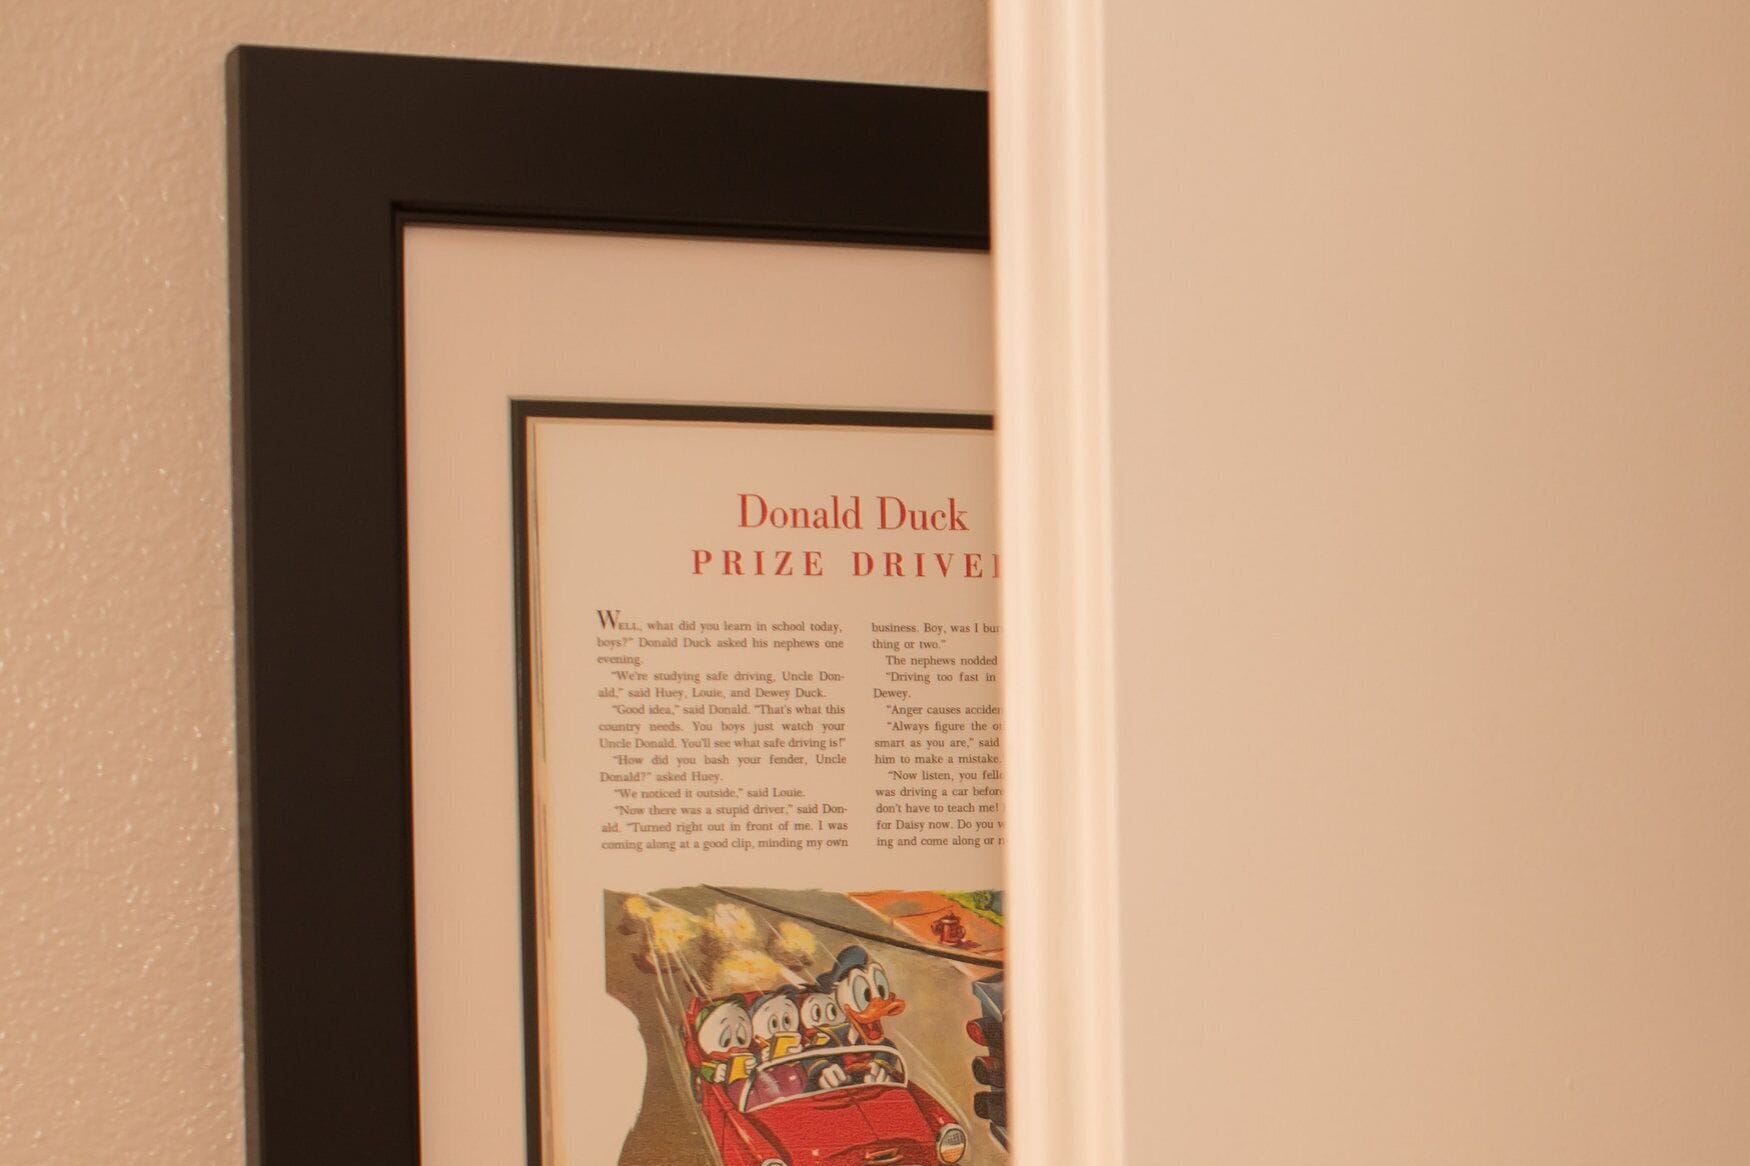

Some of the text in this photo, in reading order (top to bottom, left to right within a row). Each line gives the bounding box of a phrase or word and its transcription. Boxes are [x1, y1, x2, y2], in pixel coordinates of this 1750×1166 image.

[737, 493, 970, 531] Donald Duck
[692, 549, 825, 577] PRIZE
[647, 621, 673, 631] what
[679, 621, 695, 631] did
[701, 624, 719, 635] you
[724, 621, 751, 631] learn
[757, 621, 766, 631] in
[772, 621, 805, 631] school
[639, 638, 677, 648] Donald
[684, 638, 711, 648] Duck
[717, 638, 747, 648] asked
[752, 637, 767, 648] his
[774, 637, 819, 651] nephews
[825, 640, 843, 648] one
[872, 638, 900, 652] thing
[886, 655, 998, 669] The nephews nodded
[654, 671, 700, 685] studying
[706, 671, 728, 681] safe
[782, 671, 812, 681] Uncle
[820, 671, 844, 681] Don-
[938, 671, 952, 682] too
[960, 671, 978, 682] fast
[986, 671, 996, 682] in
[628, 688, 650, 698] said
[731, 688, 750, 698] and
[755, 687, 790, 701] Dewey
[684, 704, 705, 714] said
[796, 704, 820, 714] what
[826, 704, 844, 714] this
[599, 721, 640, 735] country
[693, 721, 712, 731] You
[721, 721, 744, 735] boys
[754, 721, 773, 735] just
[782, 721, 810, 731] watch
[822, 723, 844, 734] your
[935, 720, 965, 734] figure
[971, 720, 987, 731] the
[599, 738, 631, 748] Uncle
[734, 737, 760, 747] what
[763, 737, 785, 747] safe
[789, 737, 826, 751] driving
[875, 737, 904, 747] smart
[927, 740, 944, 751] you
[979, 737, 999, 747] said
[652, 754, 668, 765] did
[676, 757, 695, 768] you
[705, 754, 729, 764] bash
[738, 757, 761, 768] your
[816, 753, 847, 764] Uncle
[875, 753, 895, 763] him
[901, 753, 910, 763] to
[915, 753, 943, 763] make
[657, 771, 687, 781] asked
[959, 772, 977, 783] you
[642, 788, 681, 798] noticed
[685, 788, 692, 798] it
[747, 787, 768, 797] said
[900, 786, 937, 800] driving
[649, 804, 676, 814] there
[716, 804, 749, 818] stupid
[797, 803, 817, 813] said
[823, 803, 847, 813] Don-
[906, 802, 930, 812] have
[934, 802, 944, 812] to
[948, 802, 975, 812] teach
[979, 801, 999, 812] me!
[677, 821, 702, 835] right
[708, 821, 725, 831] out
[731, 821, 740, 831] in
[746, 820, 772, 831] front
[779, 820, 789, 830] of
[828, 822, 848, 830] was
[877, 819, 891, 829] for
[896, 819, 925, 833] Daisy
[958, 819, 971, 829] Do
[976, 821, 993, 832] you
[602, 839, 643, 853] coming
[646, 838, 676, 852] along
[680, 838, 689, 848] at
[703, 838, 728, 852] good
[758, 837, 802, 851] minding
[807, 840, 822, 851] my
[827, 839, 848, 847] own
[877, 836, 894, 849] ing
[898, 835, 917, 845] and
[952, 834, 980, 848] along
